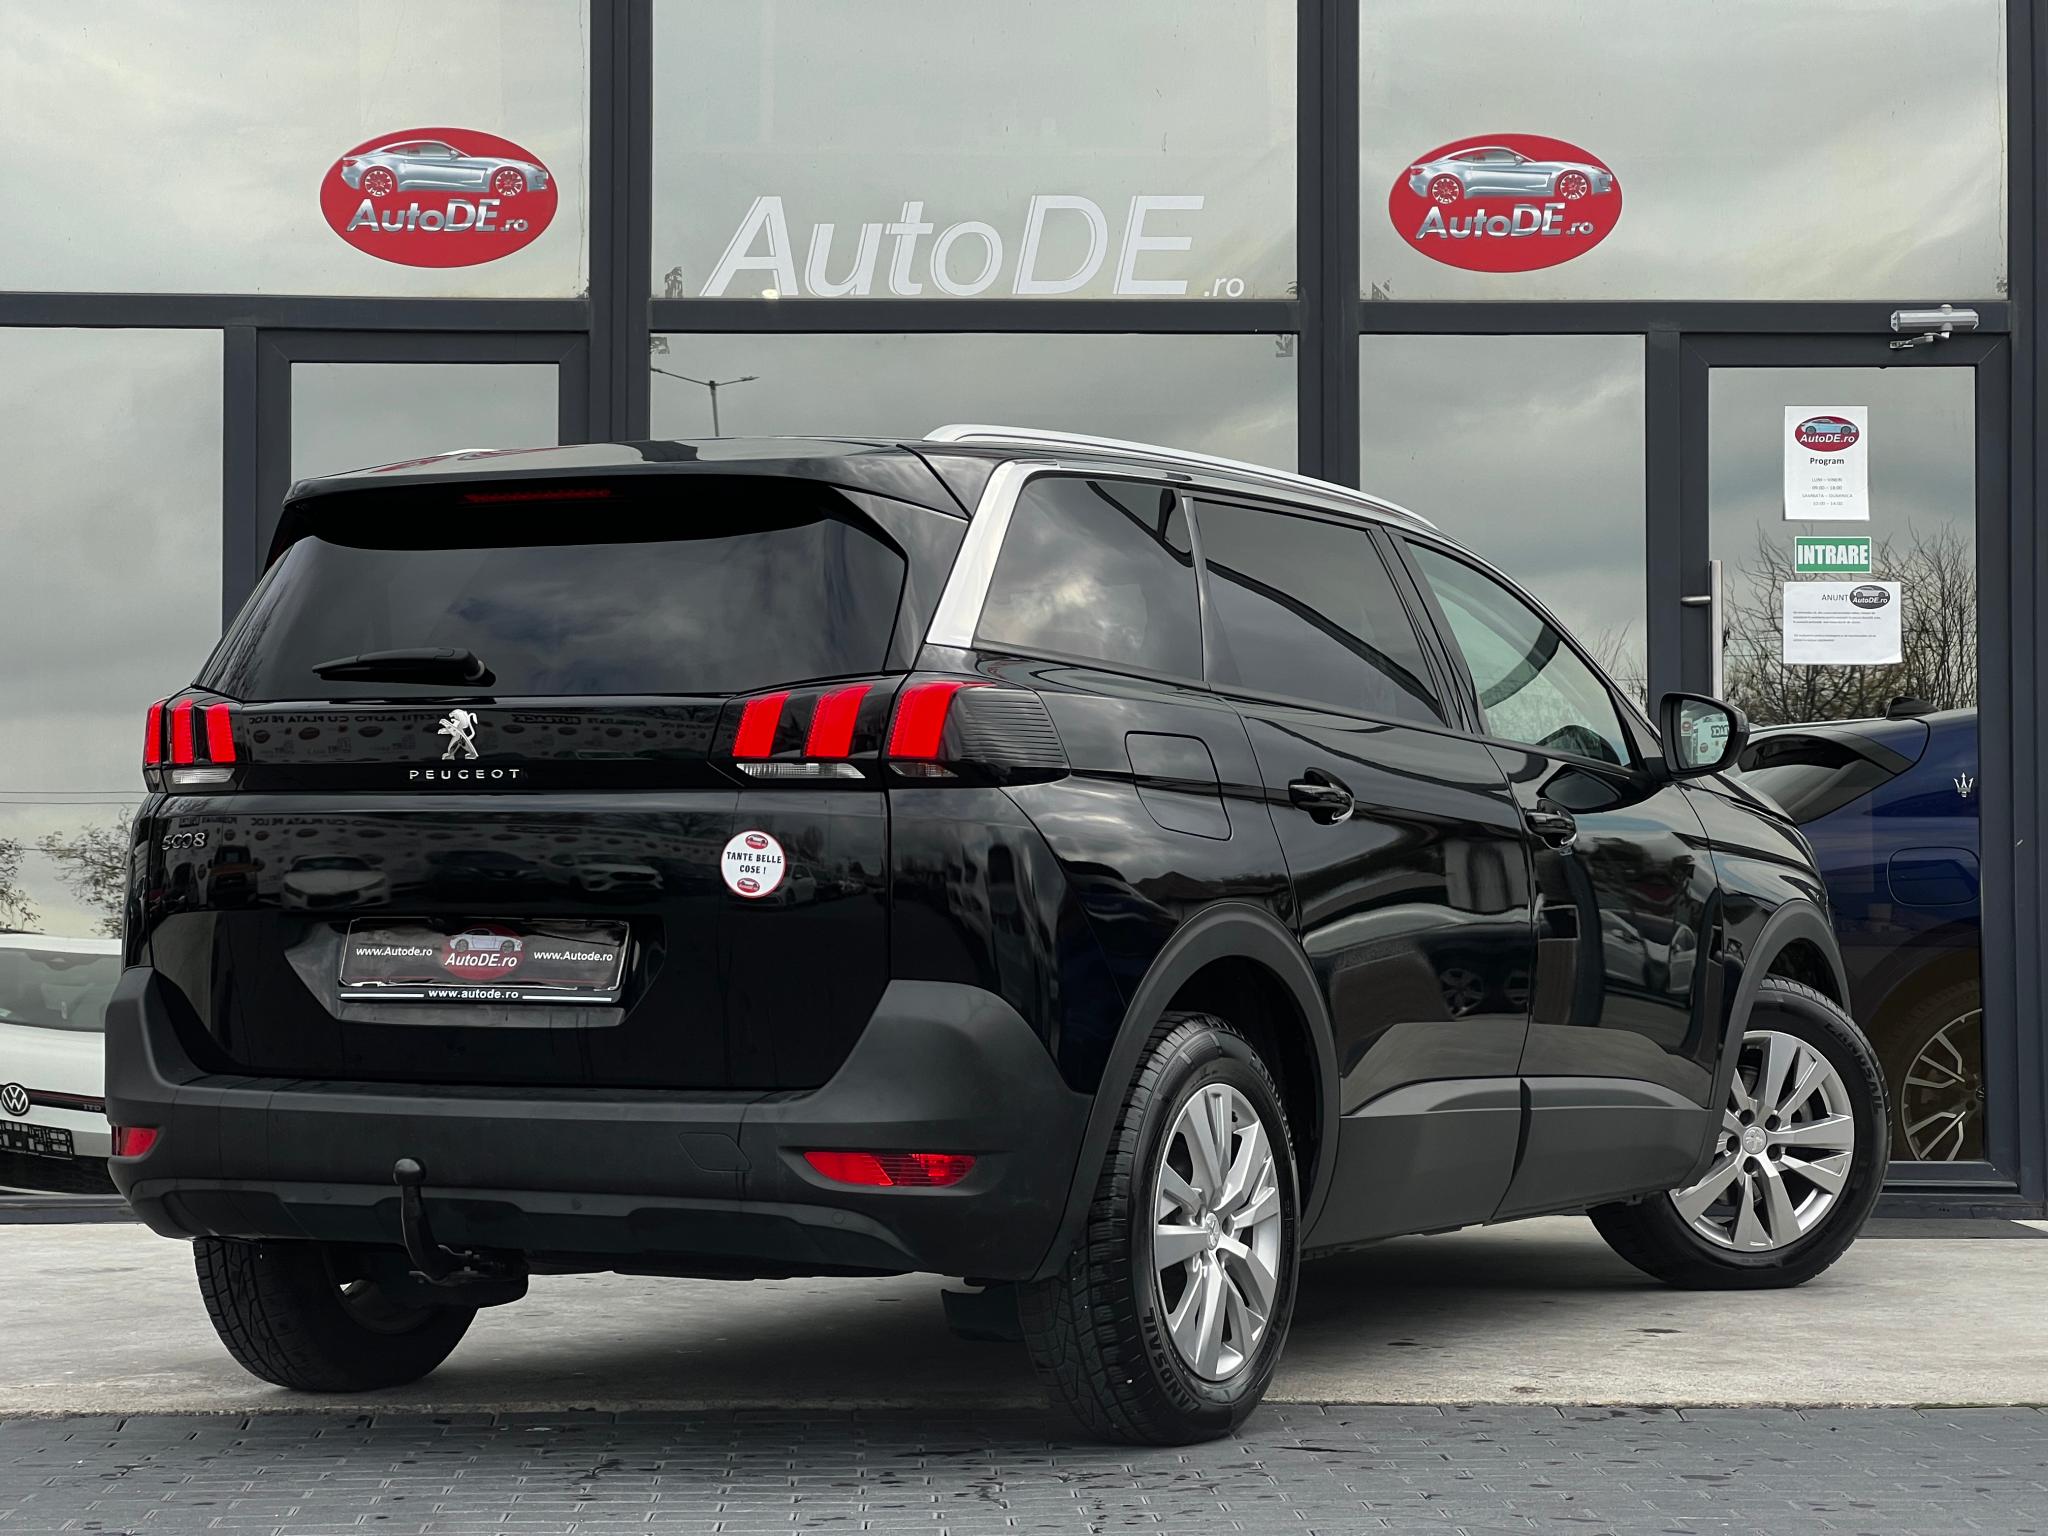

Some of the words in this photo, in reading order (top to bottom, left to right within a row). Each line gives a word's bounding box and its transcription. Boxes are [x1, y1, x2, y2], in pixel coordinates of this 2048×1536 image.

[346, 198, 529, 233] AutoDE.ro
[1416, 202, 1594, 240] AutoDE.ro
[700, 194, 1246, 297] AutoDE.ro
[1799, 434, 1855, 443] AutoDE.ro
[1809, 457, 1844, 466] Program
[1798, 545, 1868, 564] INTRARE
[409, 769, 520, 780] PEUGEOT
[161, 832, 205, 850] 5008
[726, 851, 753, 862] TANTE
[756, 853, 782, 864] BELLE
[739, 864, 761, 874] COSE
[356, 946, 433, 957] www.Autode.ro
[444, 952, 518, 968] AutoDE.ro
[533, 950, 613, 962] www.Autode.ro
[428, 988, 519, 1000] www.autode.ro
